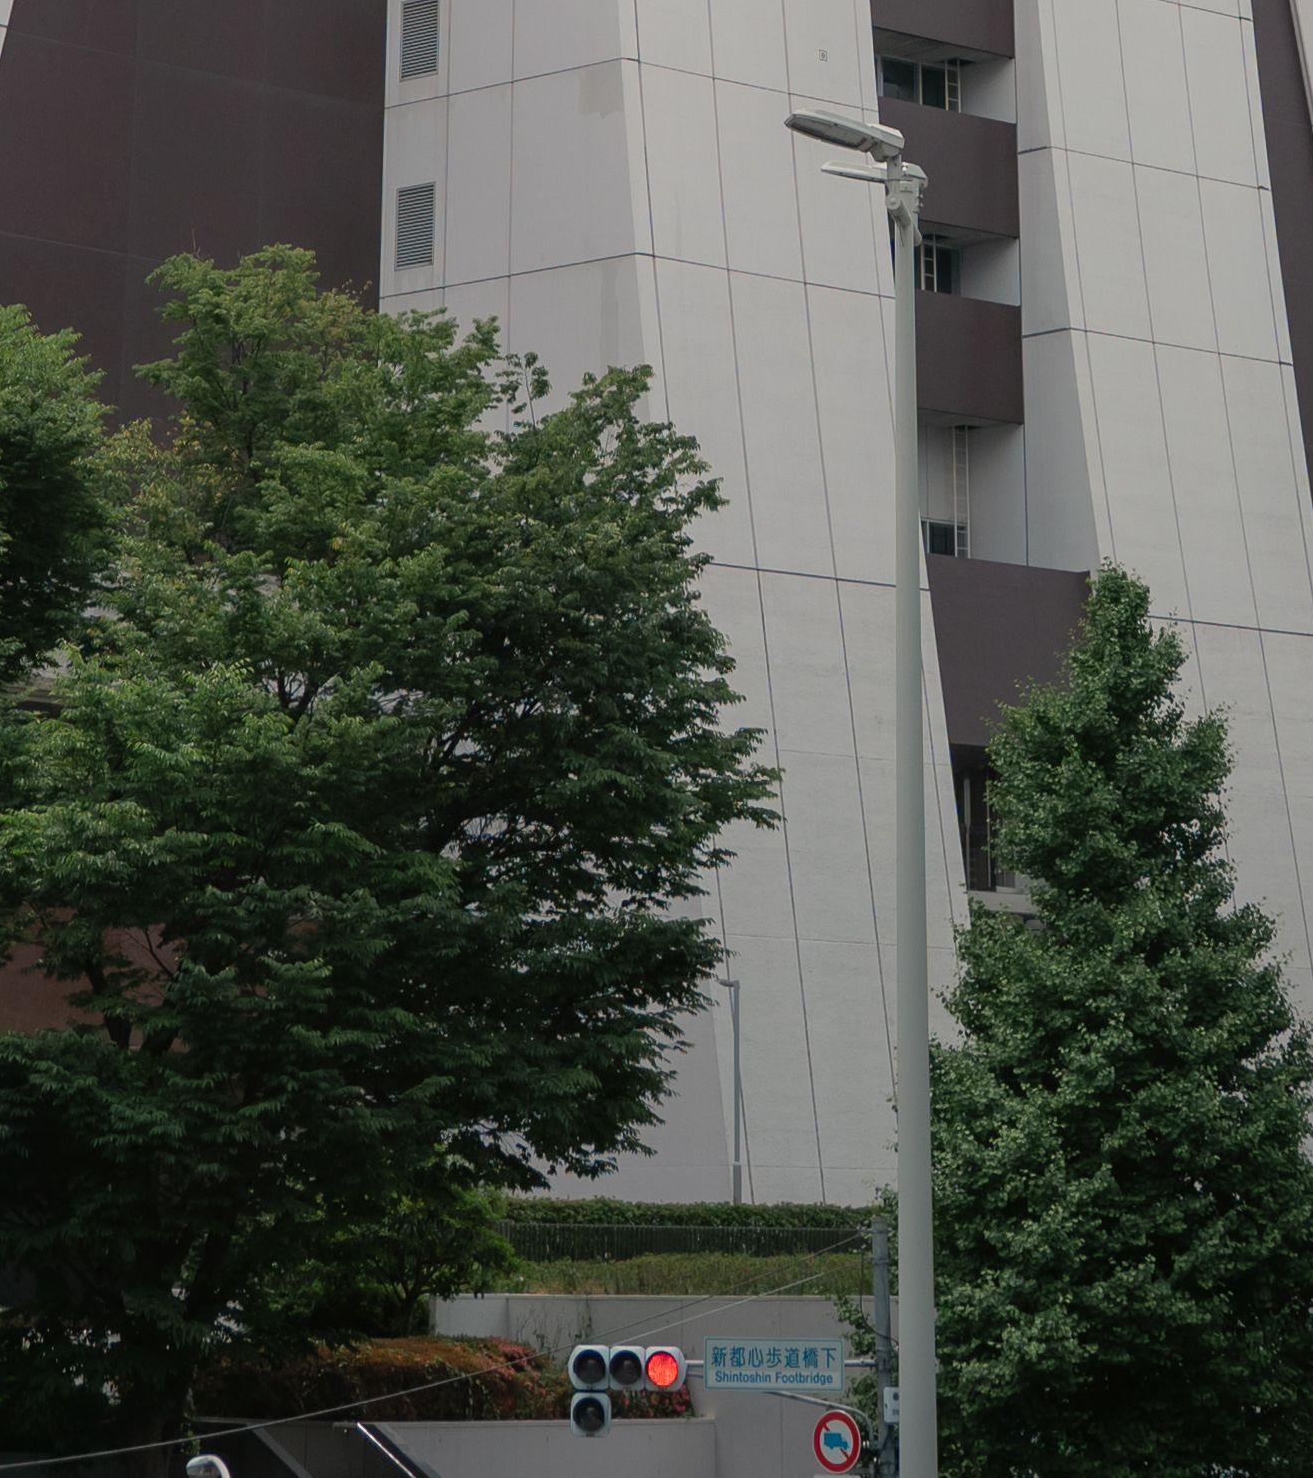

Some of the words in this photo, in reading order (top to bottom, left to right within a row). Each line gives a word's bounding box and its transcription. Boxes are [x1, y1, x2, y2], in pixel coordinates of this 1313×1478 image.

[711, 1346, 837, 1368] 新都心歩道橋下
[715, 1370, 772, 1383] Shintoshin
[775, 1371, 833, 1385] Footbridge
